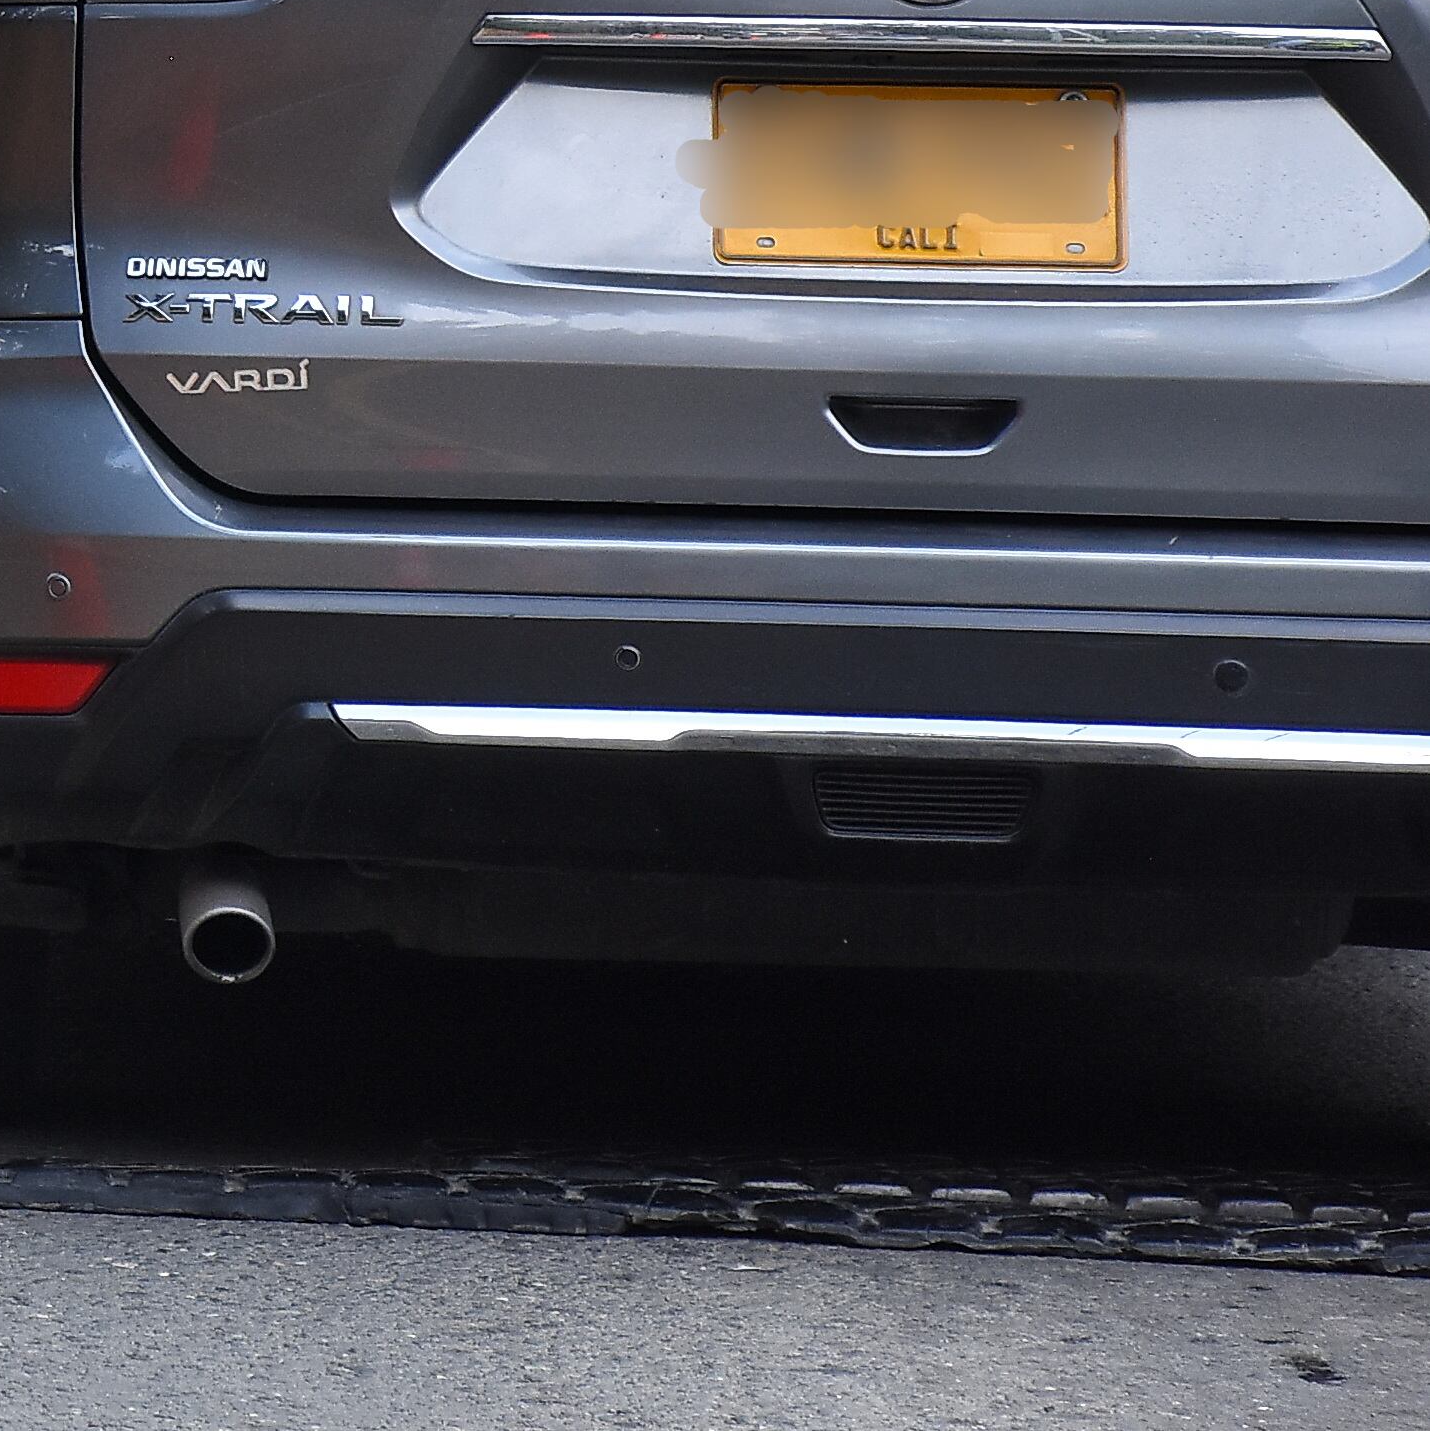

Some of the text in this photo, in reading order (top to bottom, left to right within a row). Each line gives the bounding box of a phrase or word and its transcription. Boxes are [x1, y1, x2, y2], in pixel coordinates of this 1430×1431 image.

[875, 223, 959, 251] CALI
[126, 256, 268, 280] DINISSAN
[123, 293, 405, 326] X-TRAIL
